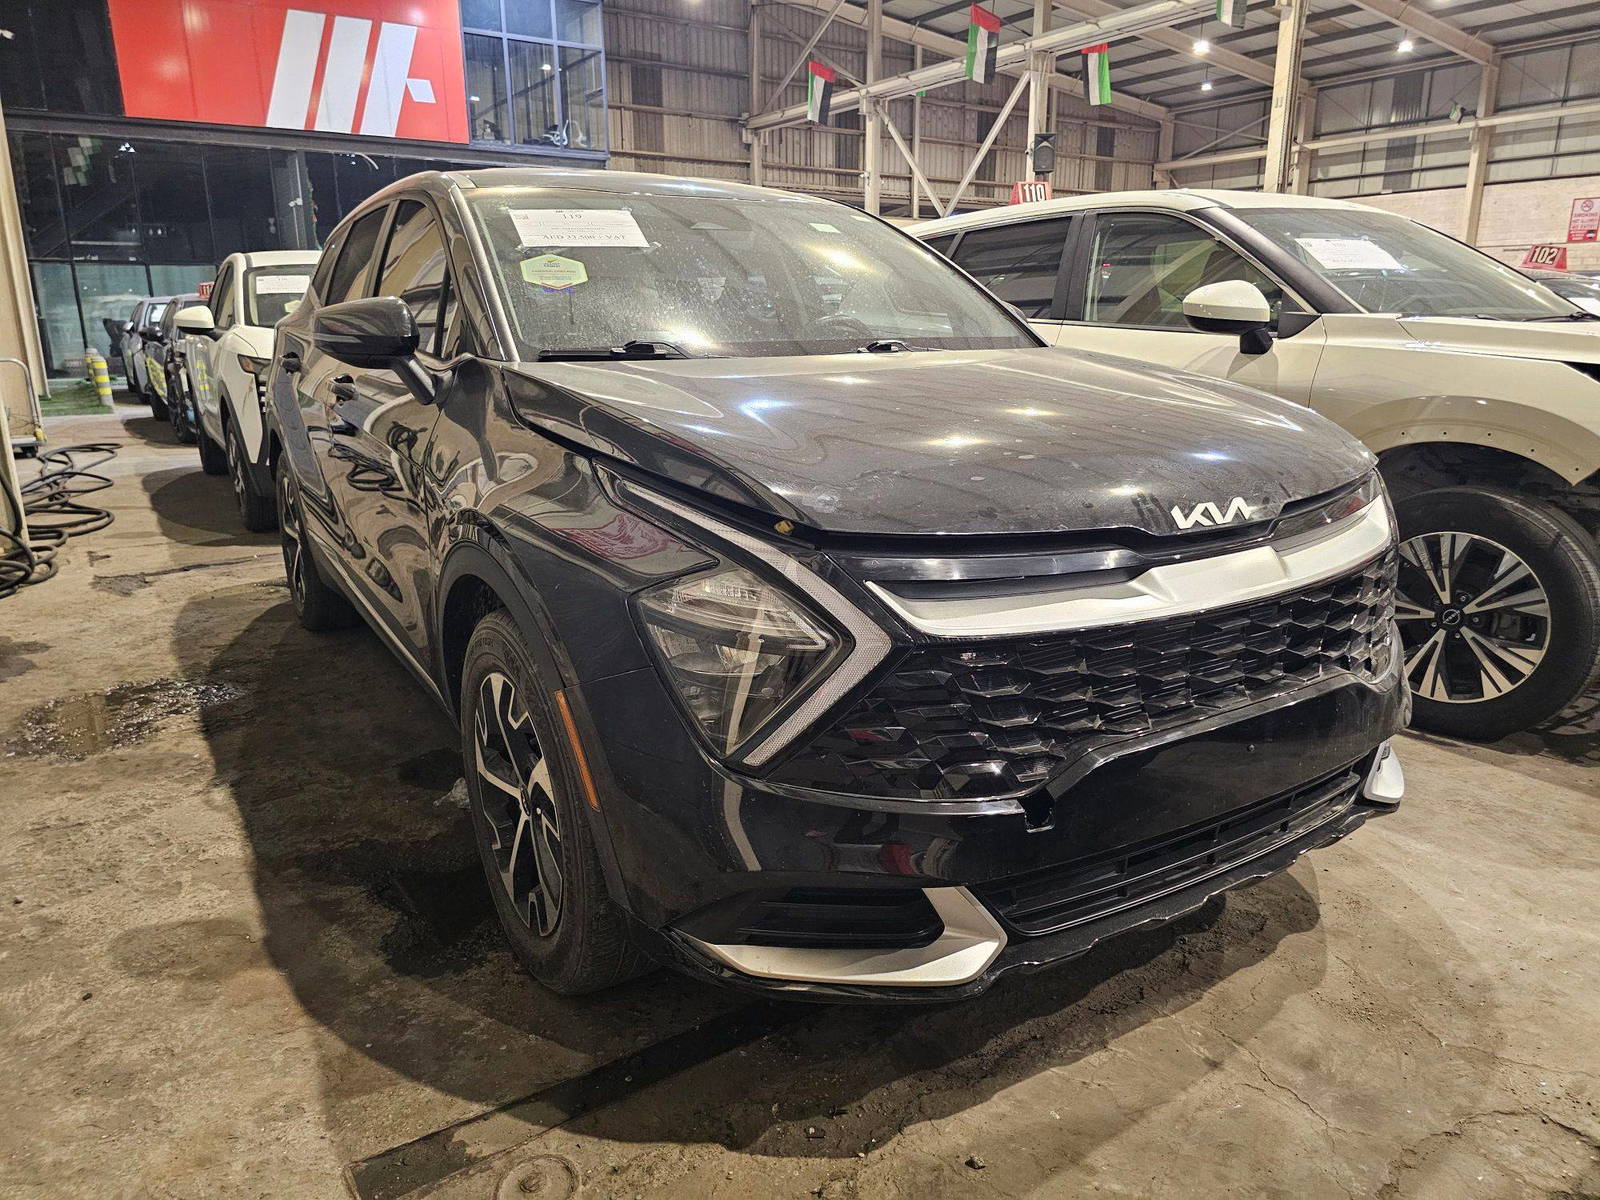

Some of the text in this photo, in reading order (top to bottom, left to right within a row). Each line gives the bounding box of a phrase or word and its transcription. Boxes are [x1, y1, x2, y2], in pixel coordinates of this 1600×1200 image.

[1023, 183, 1046, 202] 110
[1532, 248, 1558, 264] 102
[1171, 496, 1252, 530] KIA
